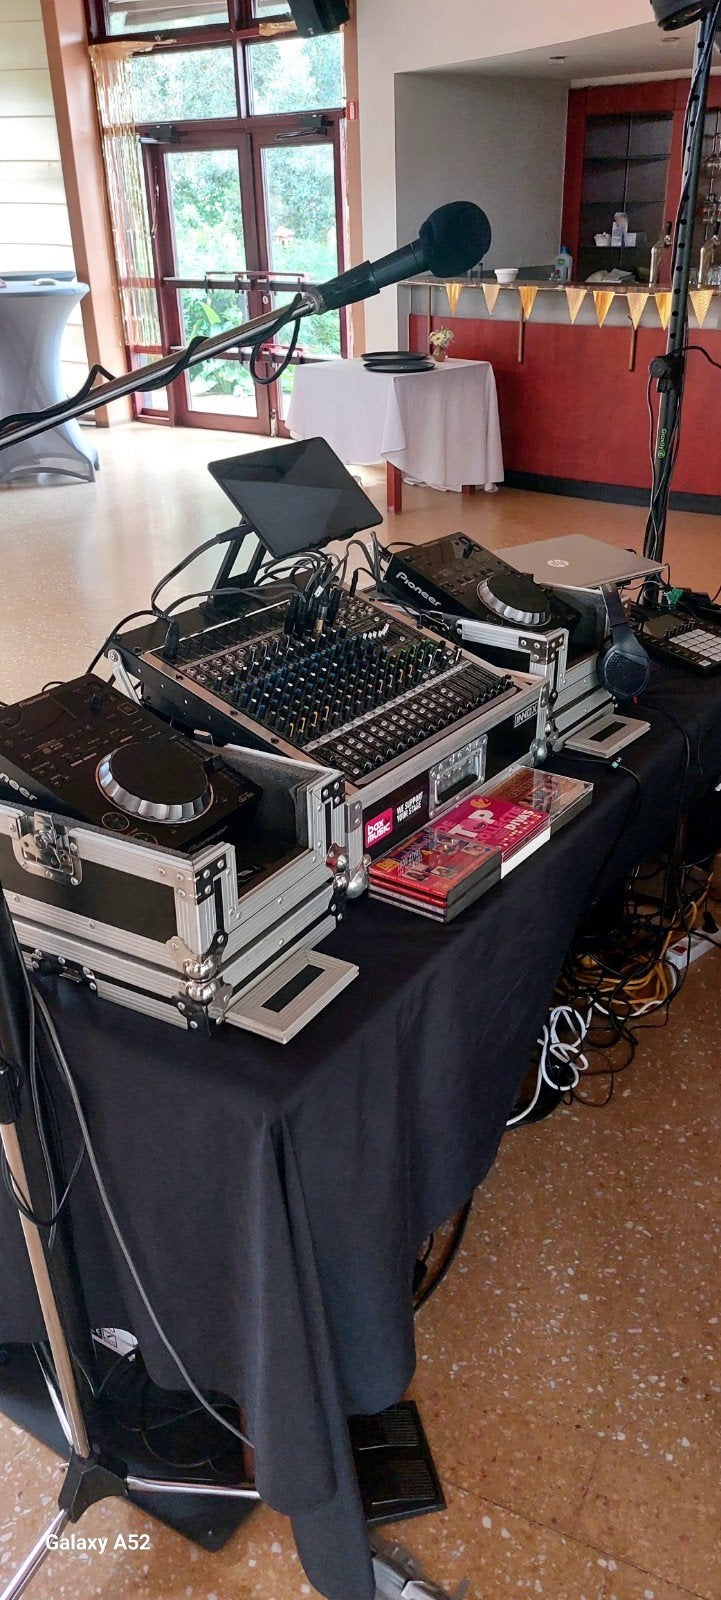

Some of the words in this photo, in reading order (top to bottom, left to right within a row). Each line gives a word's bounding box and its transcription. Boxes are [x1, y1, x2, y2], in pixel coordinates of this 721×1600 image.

[396, 572, 441, 606] Pioneer
[367, 819, 385, 836] box
[504, 809, 535, 831] DIVAS
